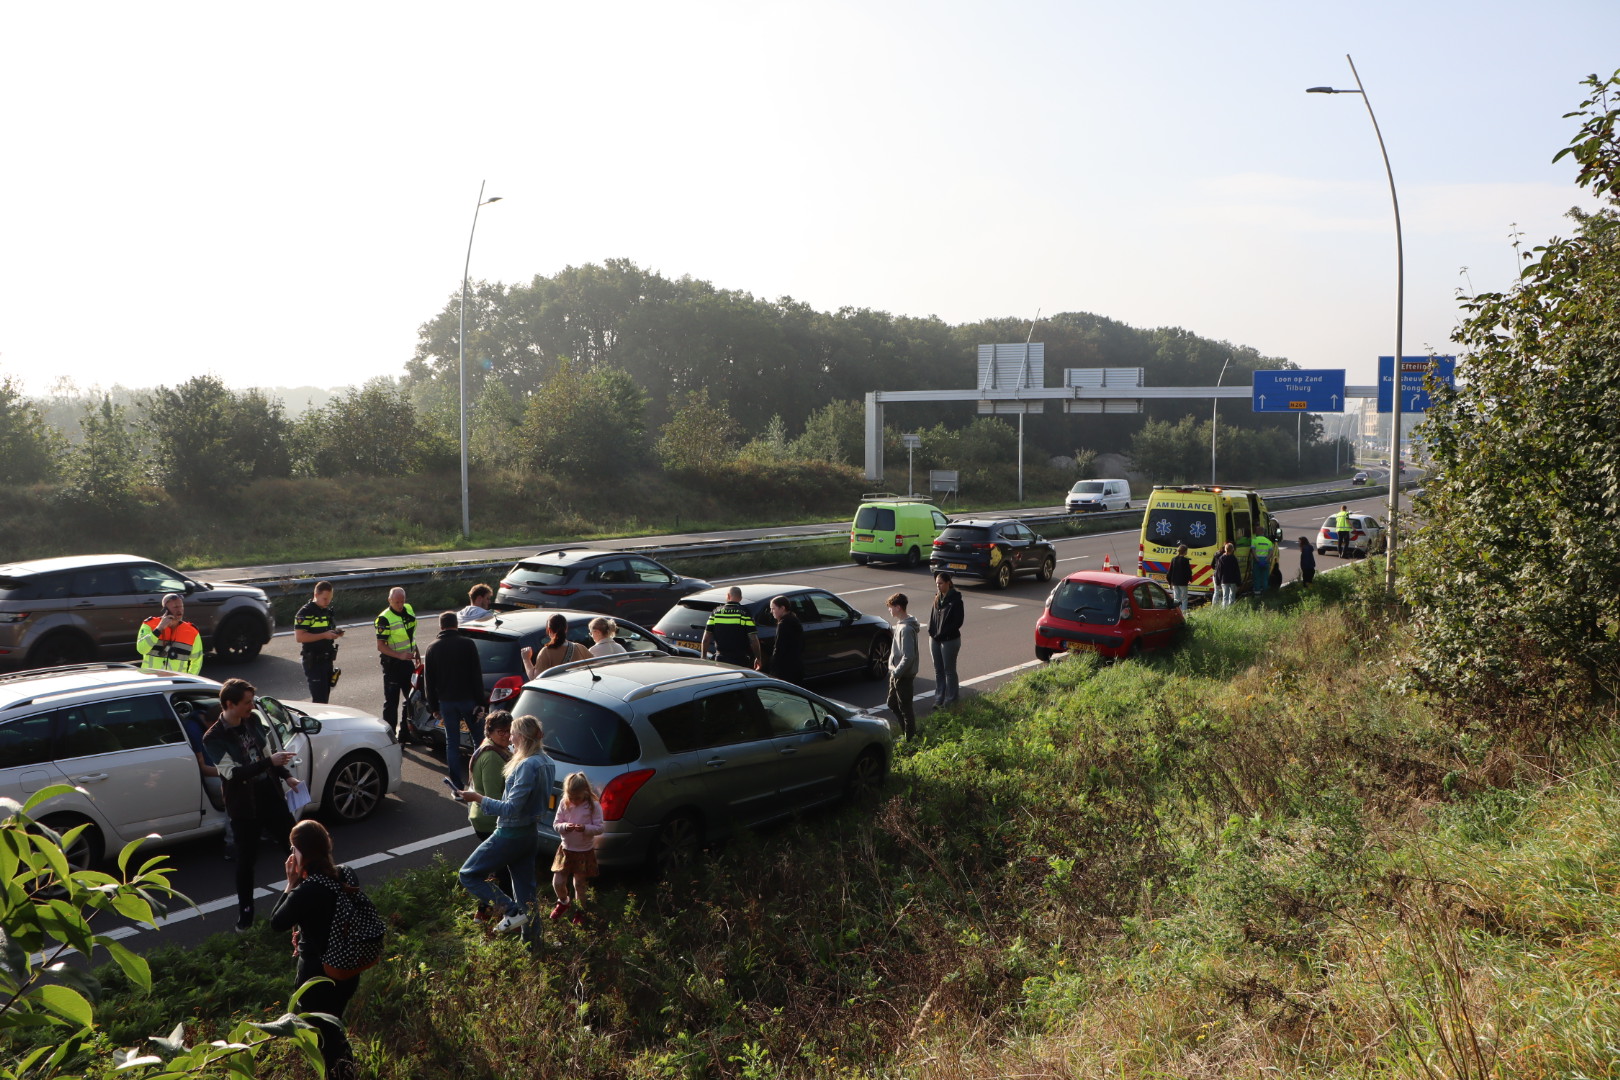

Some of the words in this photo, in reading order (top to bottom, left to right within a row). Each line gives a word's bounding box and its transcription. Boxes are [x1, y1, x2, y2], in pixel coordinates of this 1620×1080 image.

[1401, 363, 1432, 372] Efteling
[1285, 384, 1311, 392] Tilburg
[1401, 384, 1423, 392] Dong
[1155, 501, 1213, 511] AMBULANCE
